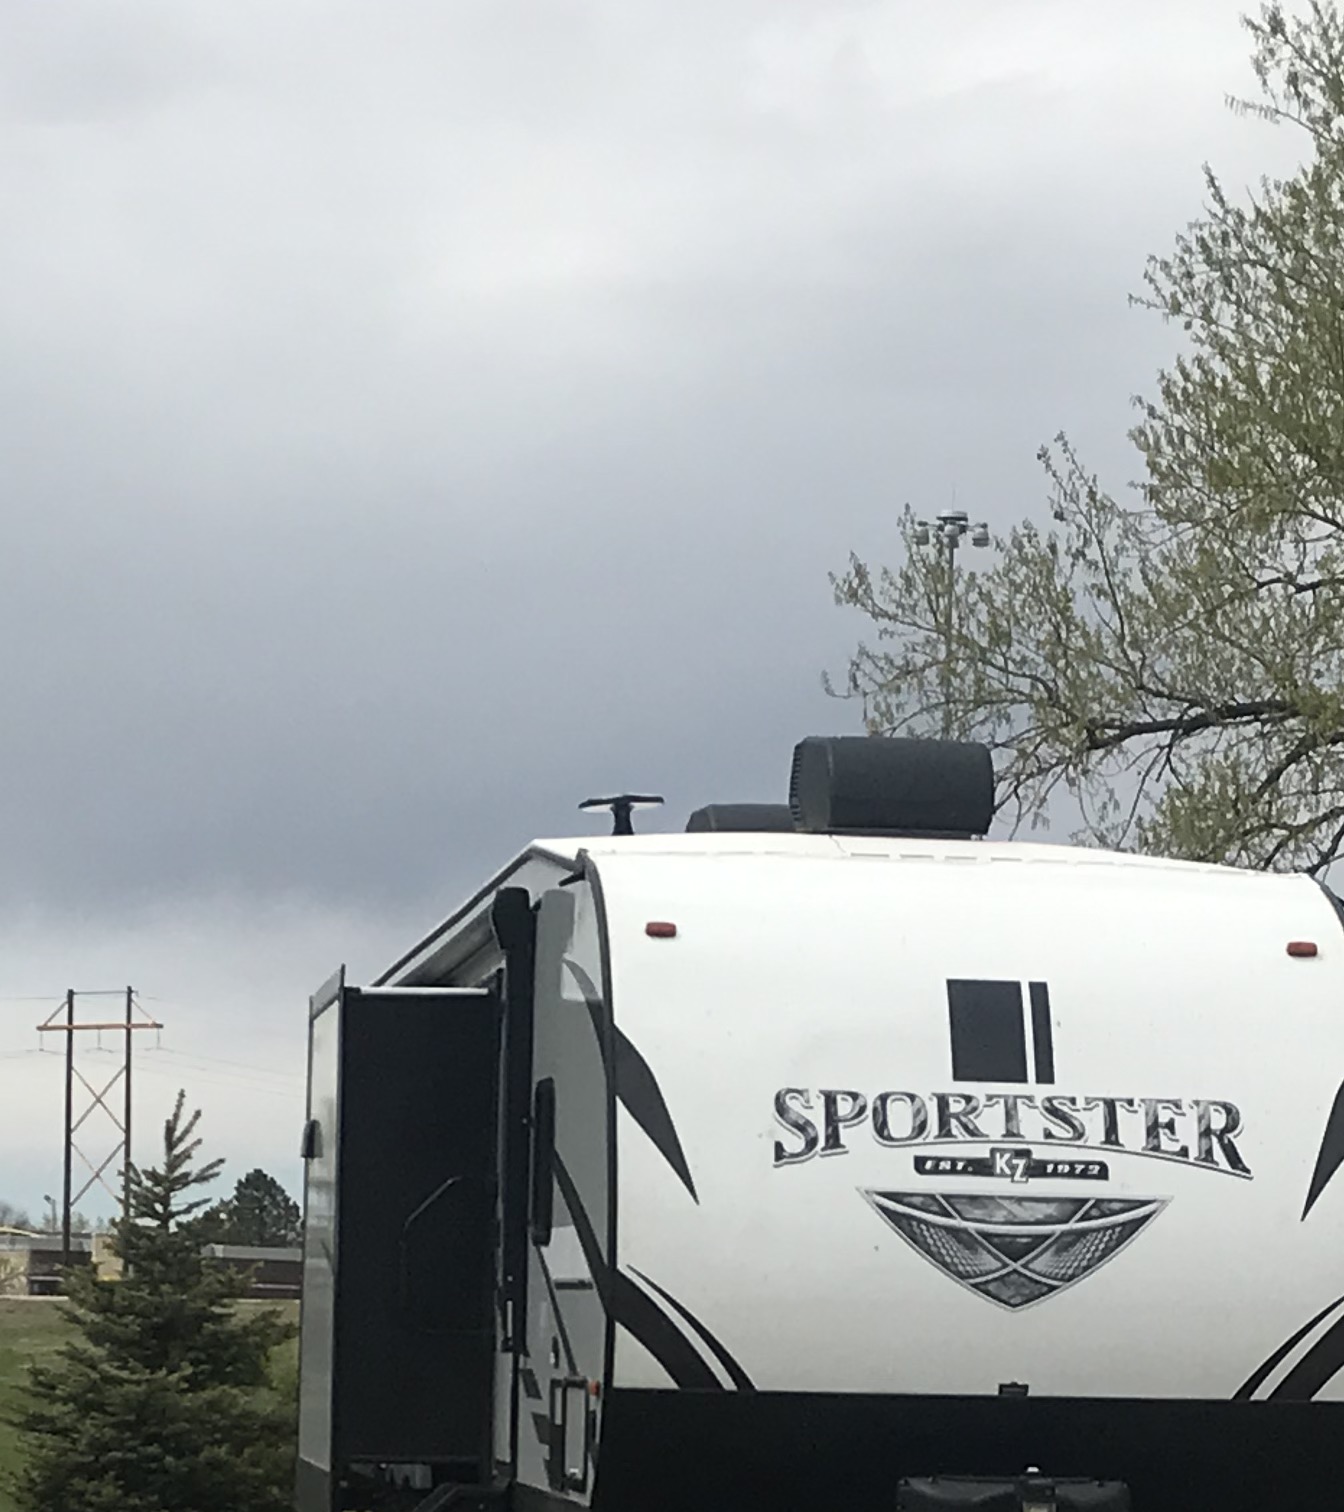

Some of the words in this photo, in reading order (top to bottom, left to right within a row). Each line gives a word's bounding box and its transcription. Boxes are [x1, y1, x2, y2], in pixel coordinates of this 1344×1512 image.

[772, 1087, 1253, 1178] SPORTSTER
[923, 1159, 974, 1173] EST.
[995, 1151, 1028, 1183] KZ
